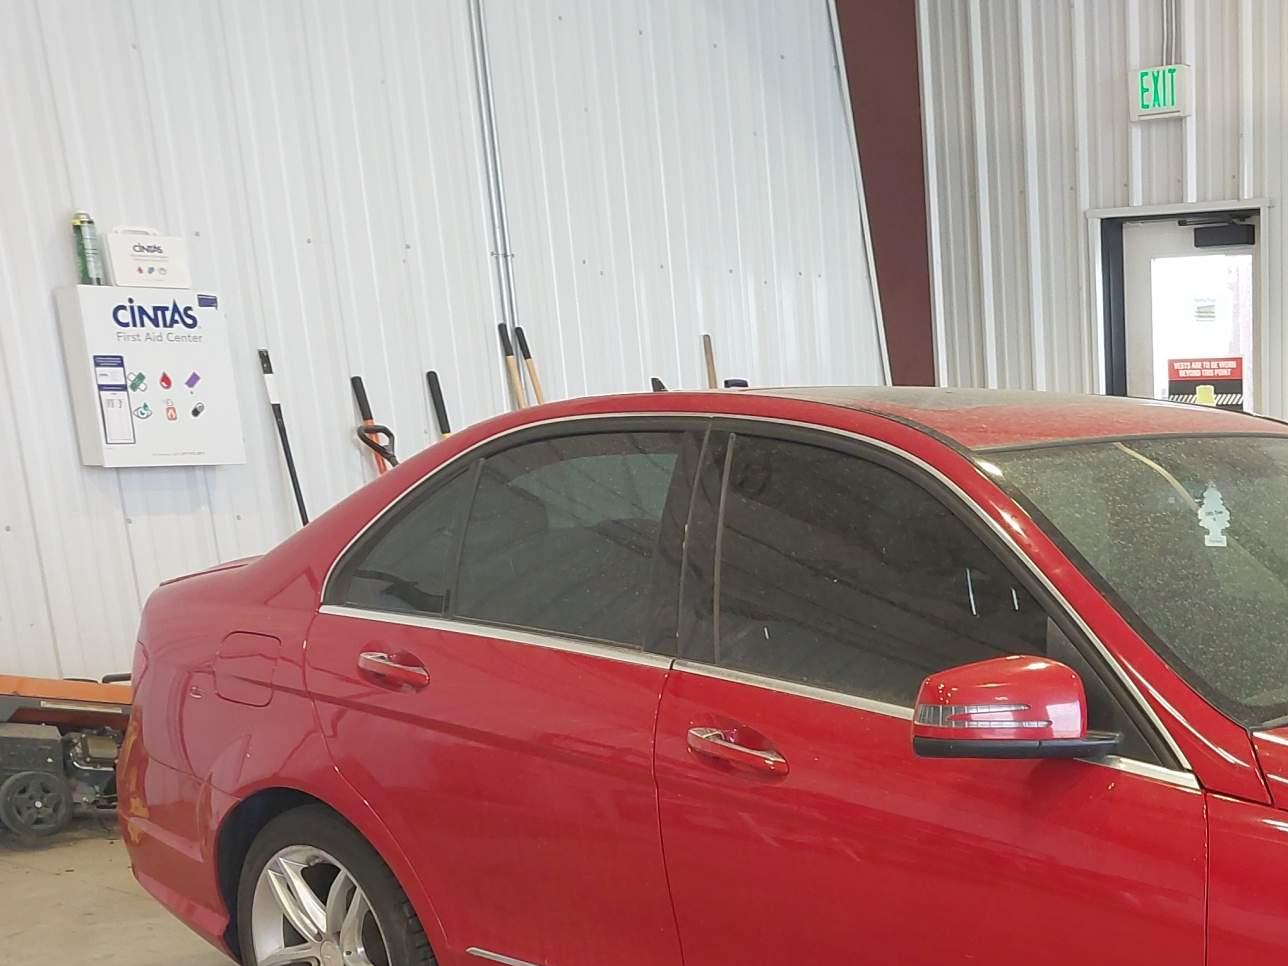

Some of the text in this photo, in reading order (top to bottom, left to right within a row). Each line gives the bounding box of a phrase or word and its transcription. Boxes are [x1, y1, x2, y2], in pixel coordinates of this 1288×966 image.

[1140, 68, 1176, 109] EXIT
[116, 332, 202, 342] First Aid Center
